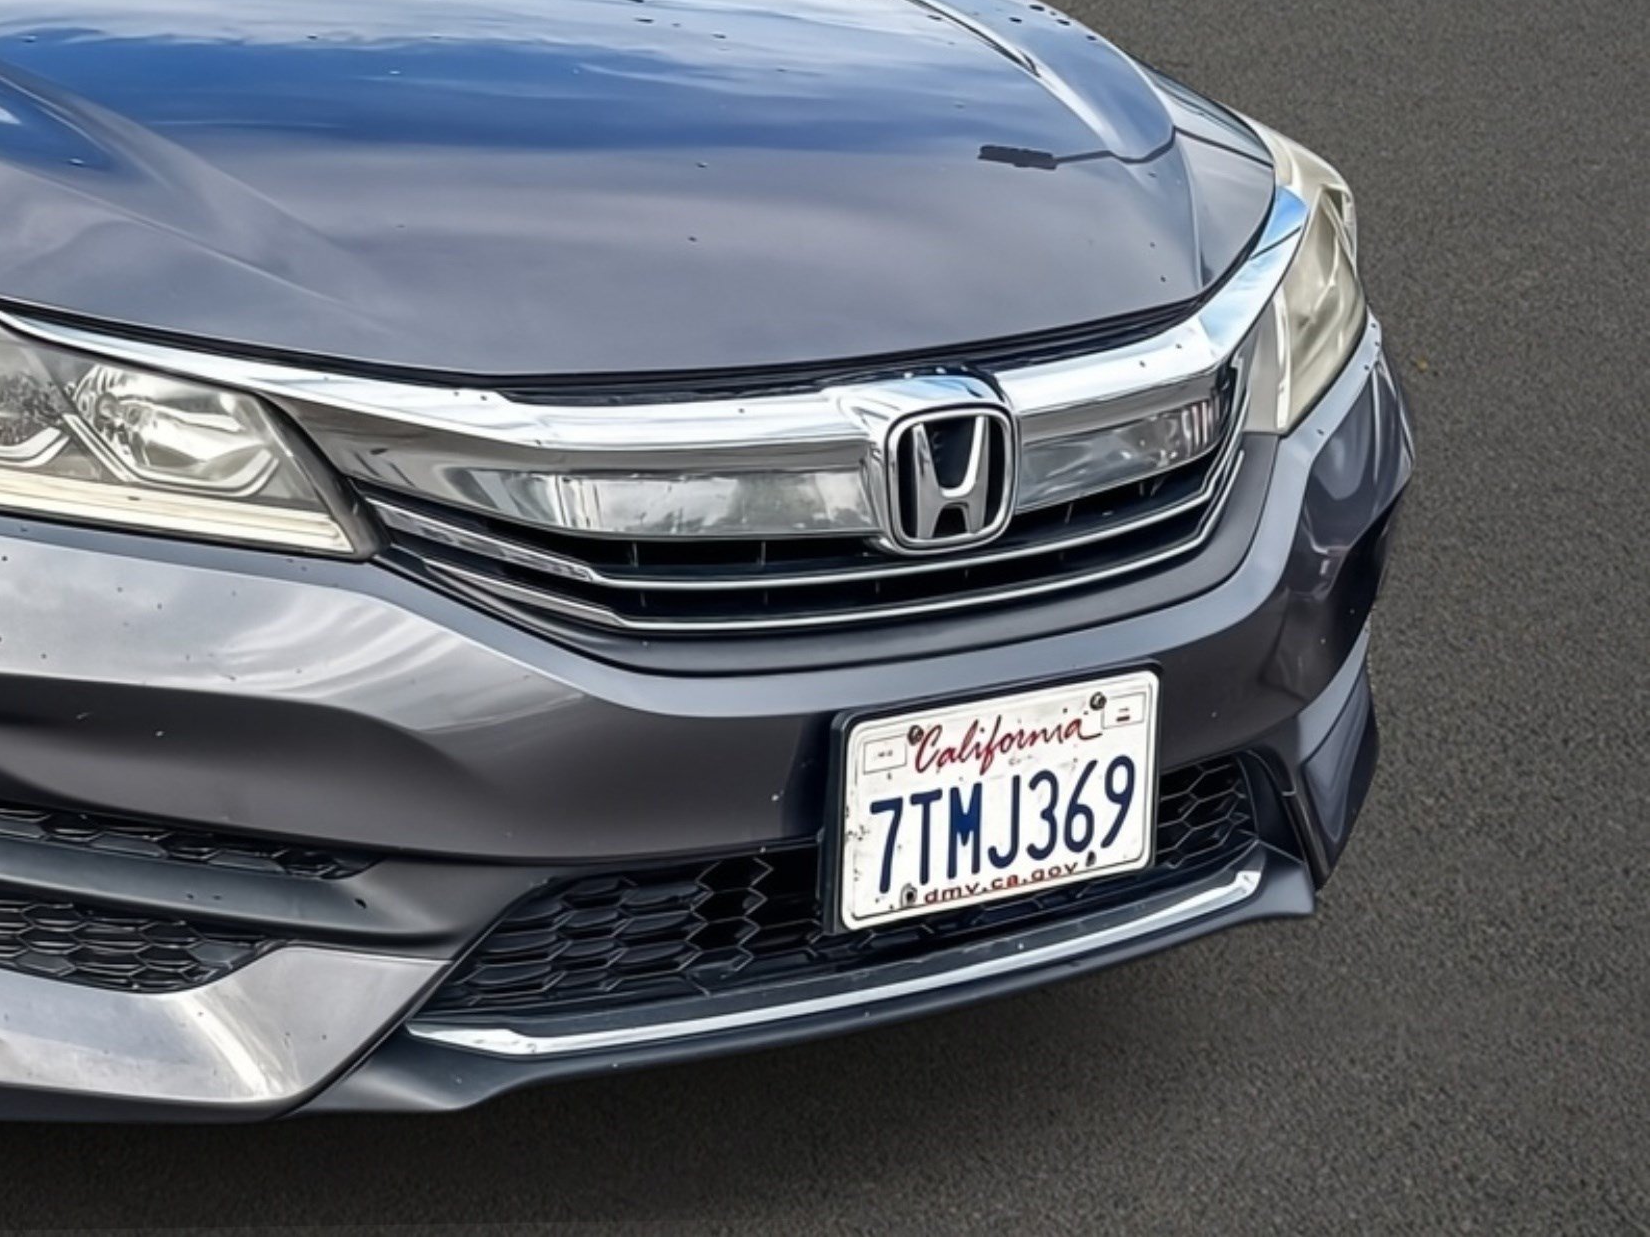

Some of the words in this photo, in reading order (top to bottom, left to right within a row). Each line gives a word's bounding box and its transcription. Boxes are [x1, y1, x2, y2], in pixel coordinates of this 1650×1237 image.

[913, 715, 1103, 775] California
[870, 754, 1136, 894] 7TMJ369
[924, 861, 1079, 905] dmv.ca.gov
